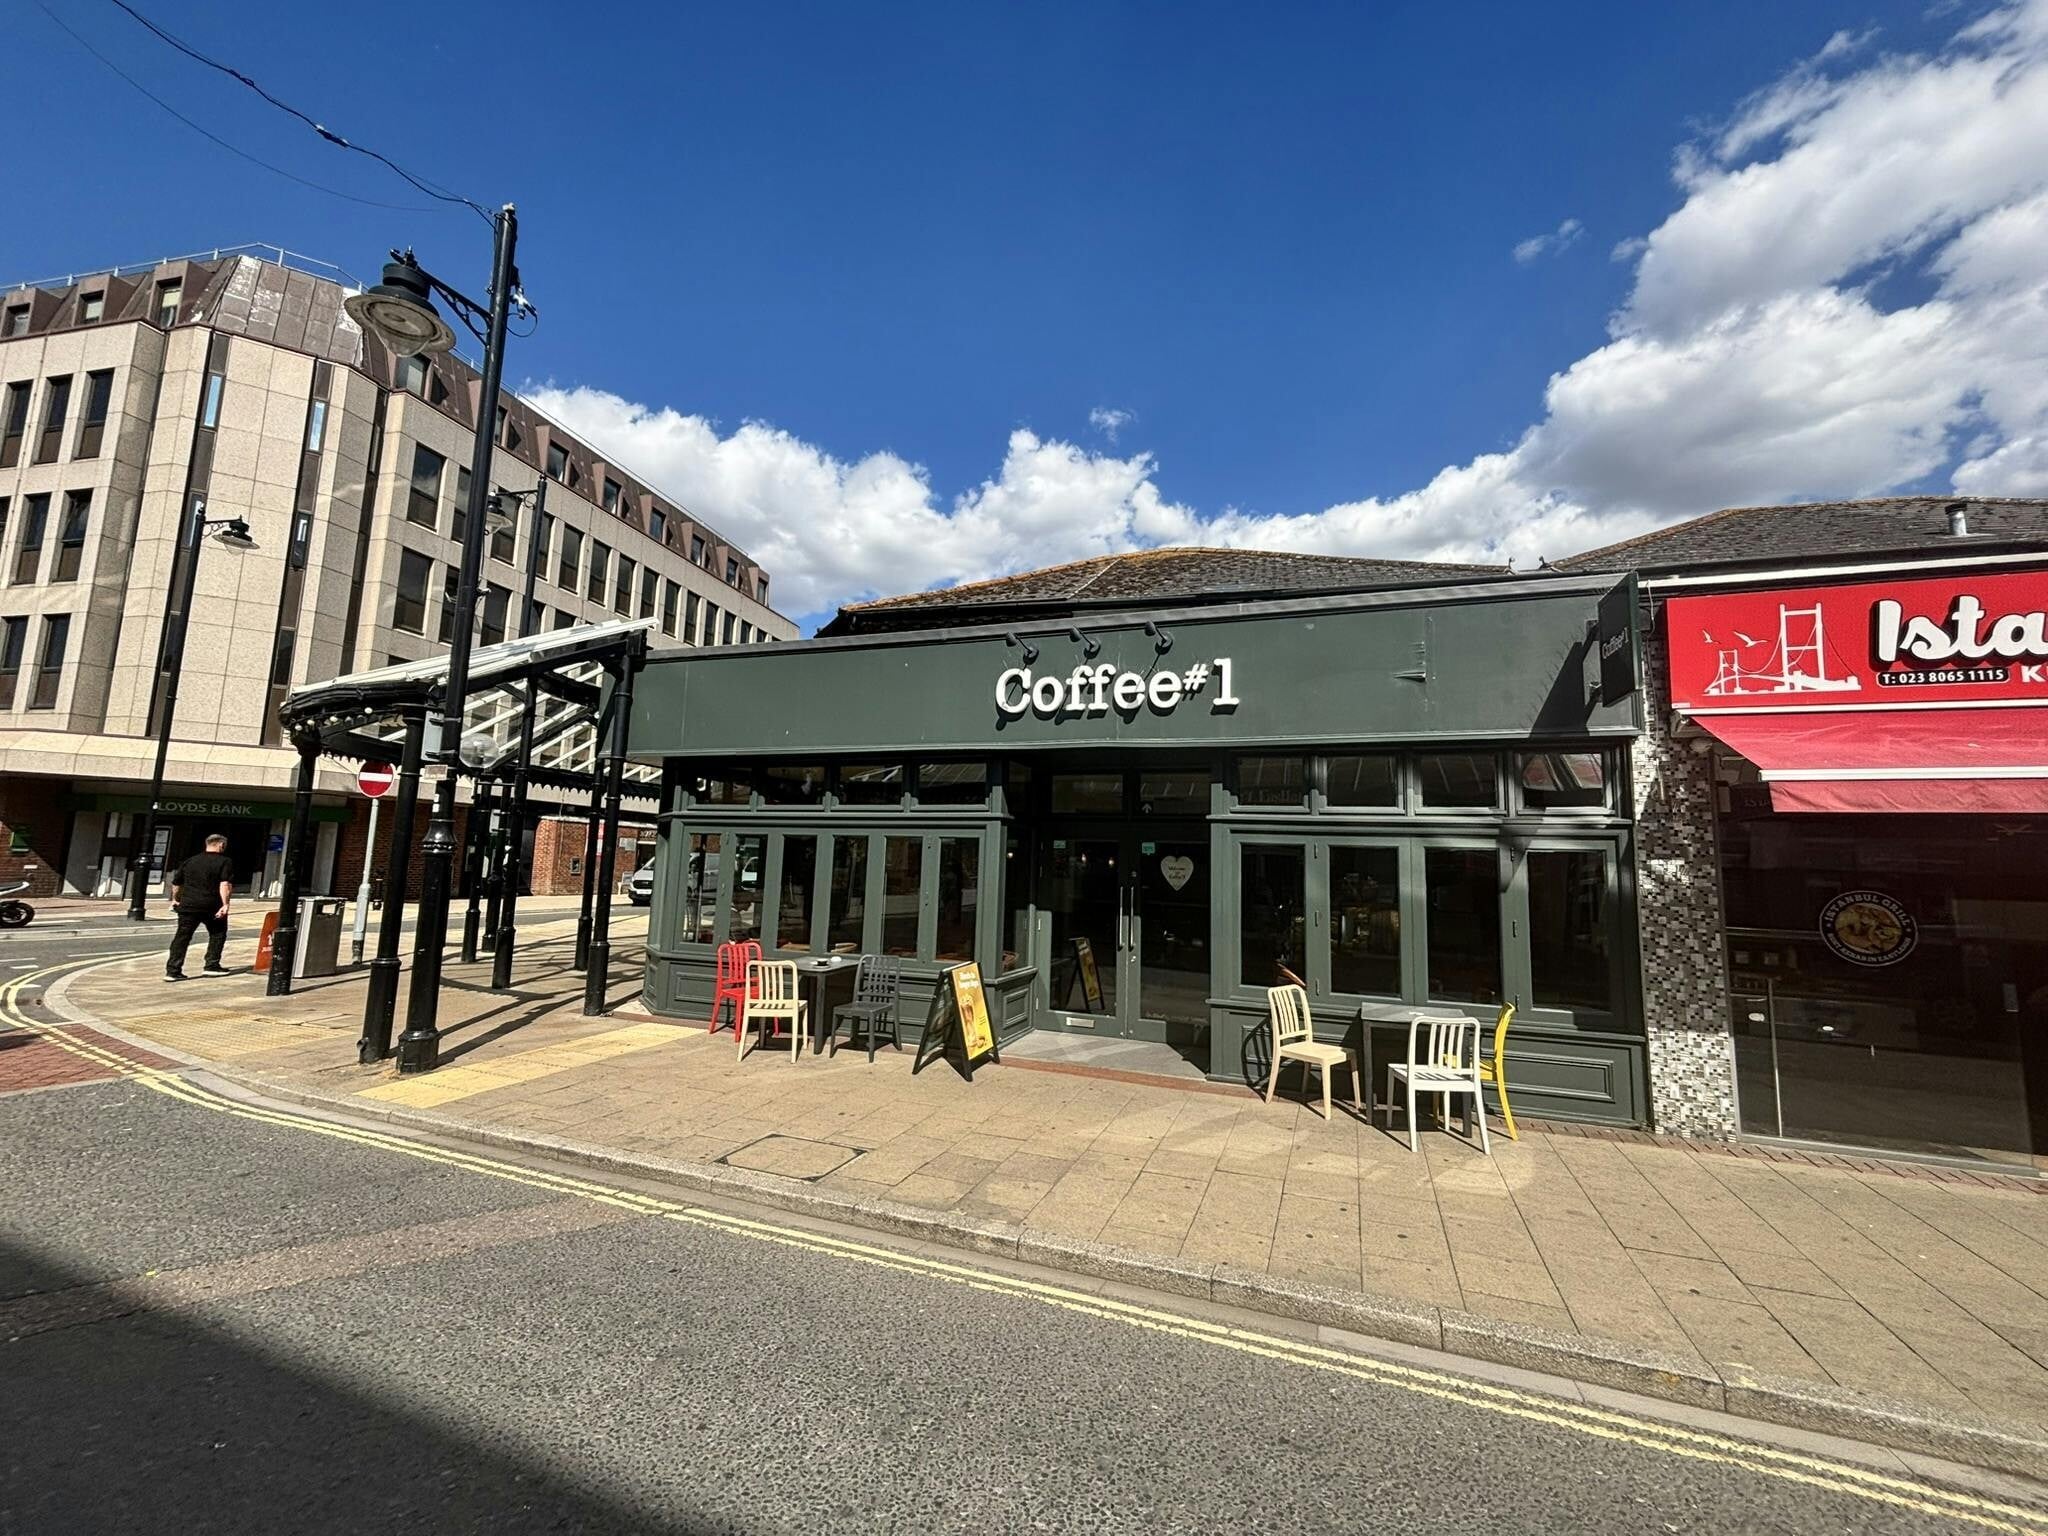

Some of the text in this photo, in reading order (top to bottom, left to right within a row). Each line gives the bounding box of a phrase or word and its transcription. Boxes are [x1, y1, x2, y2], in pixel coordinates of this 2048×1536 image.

[1882, 669, 2004, 684] T: 023 8065 1115
[2021, 664, 2048, 683] K
[995, 658, 1240, 714] Coffee#1
[211, 804, 252, 815] BANK
[1825, 894, 1910, 926] ISTANBUL GRILL
